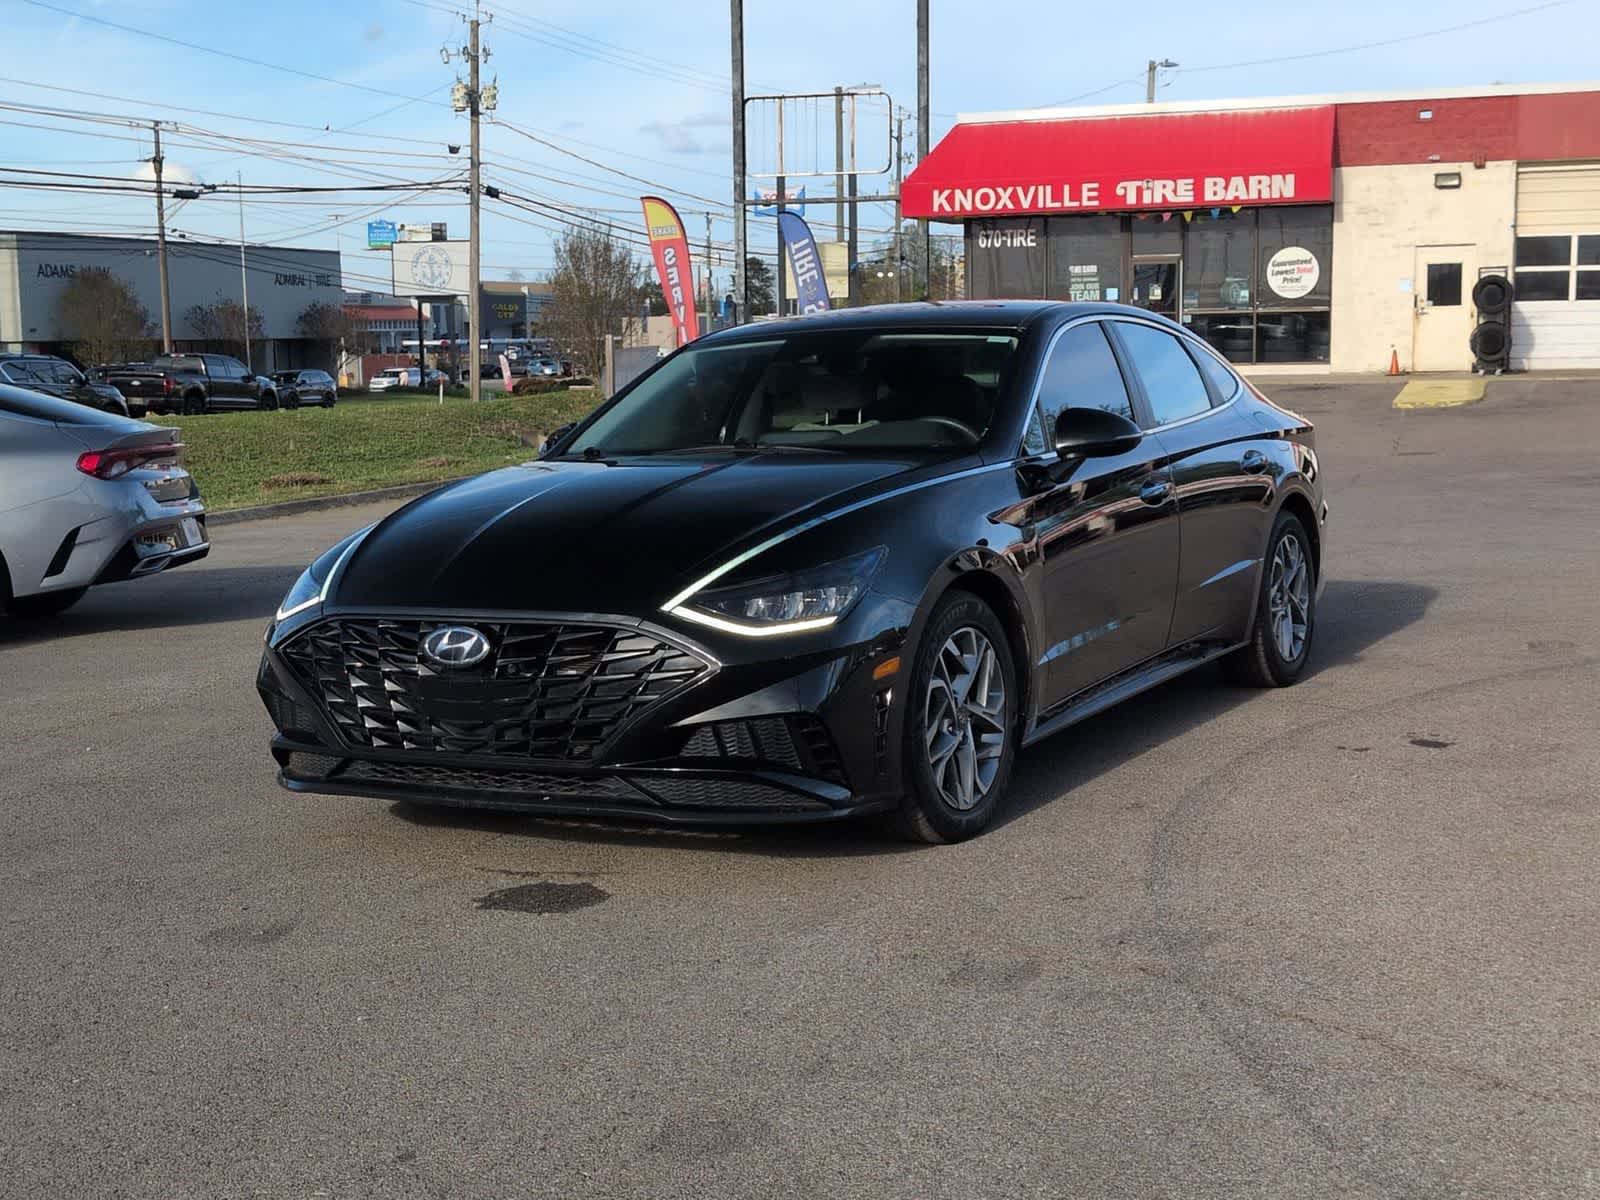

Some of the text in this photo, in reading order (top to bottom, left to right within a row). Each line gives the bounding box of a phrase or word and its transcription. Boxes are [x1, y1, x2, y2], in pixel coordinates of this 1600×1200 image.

[932, 182, 1099, 212] KNOXVILLE
[1204, 174, 1295, 201] BARN
[978, 229, 1037, 248] 670-TIRE
[1070, 290, 1100, 300] TEAM
